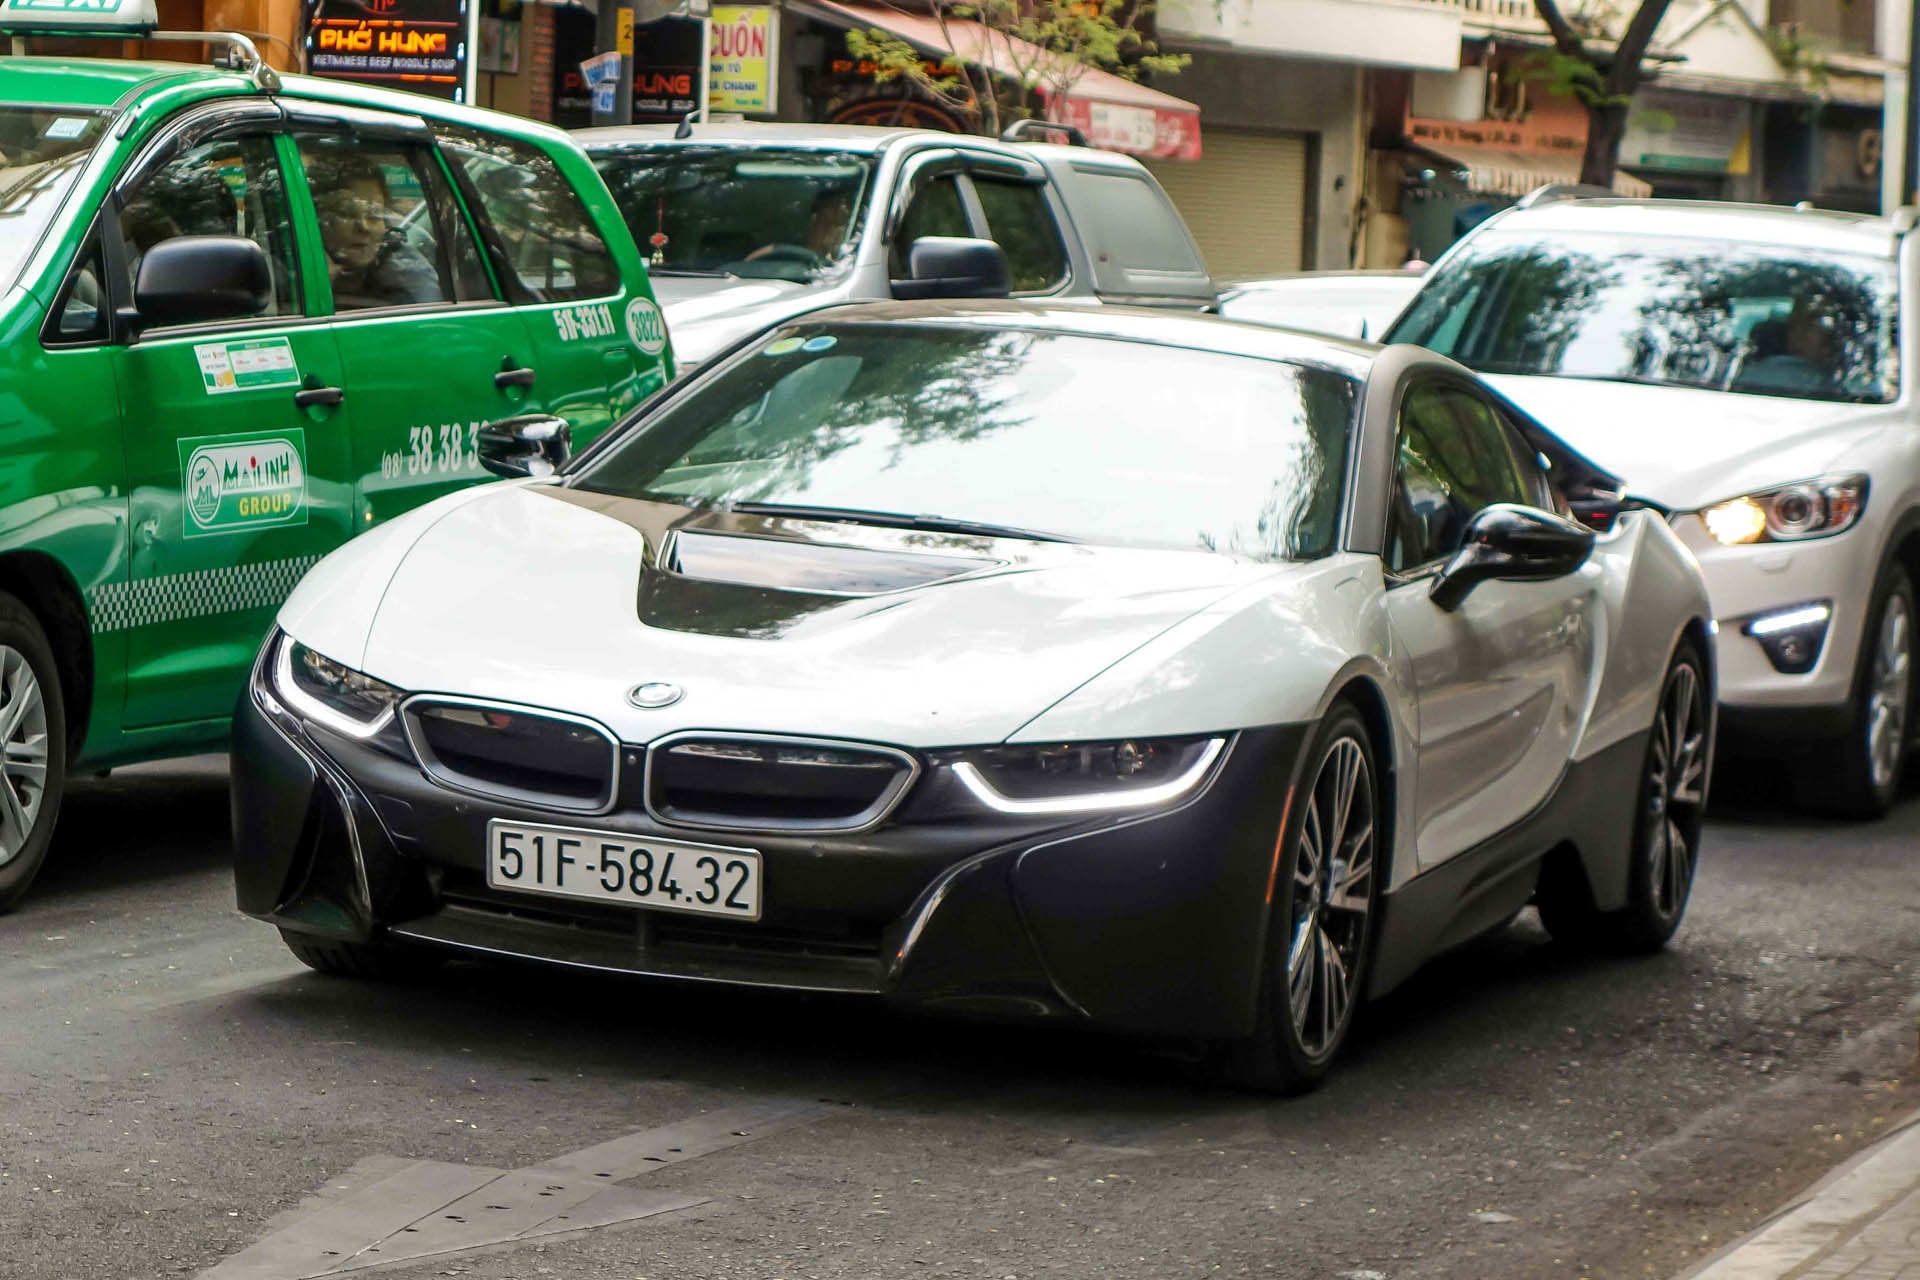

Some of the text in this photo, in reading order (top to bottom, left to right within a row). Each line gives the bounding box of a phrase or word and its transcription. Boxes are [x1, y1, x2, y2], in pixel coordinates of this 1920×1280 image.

[369, 55, 392, 69] BEEF
[392, 57, 429, 70] NOODLE
[430, 58, 457, 71] SOUP
[631, 310, 663, 342] 3822
[381, 447, 404, 480] (08)
[408, 424, 433, 477] 38
[438, 422, 463, 474] 38
[239, 494, 292, 517] GROUP
[499, 831, 751, 912] 51F-584.32
